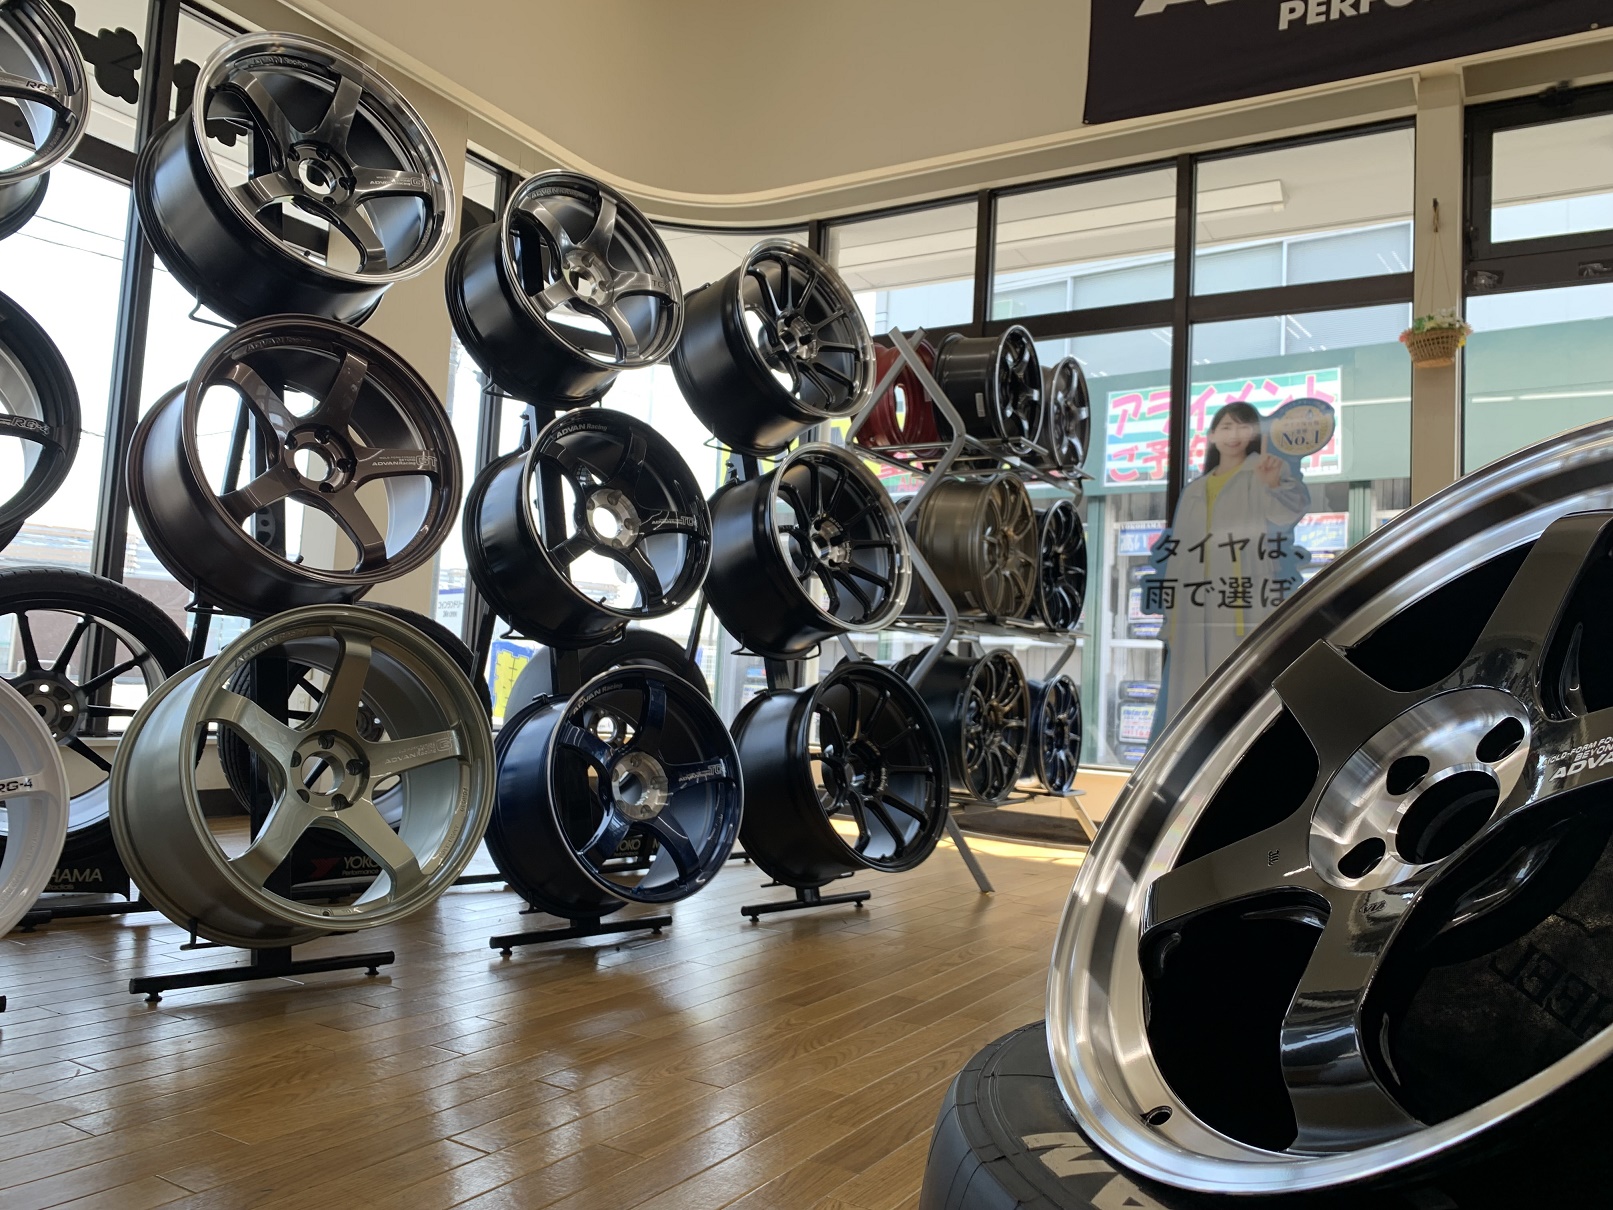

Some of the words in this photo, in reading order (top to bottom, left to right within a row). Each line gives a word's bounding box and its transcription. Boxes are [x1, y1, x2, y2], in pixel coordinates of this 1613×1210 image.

[1278, 0, 1413, 31] PER
[556, 423, 586, 439] ADVAN
[1155, 532, 1305, 563] タイヤは、
